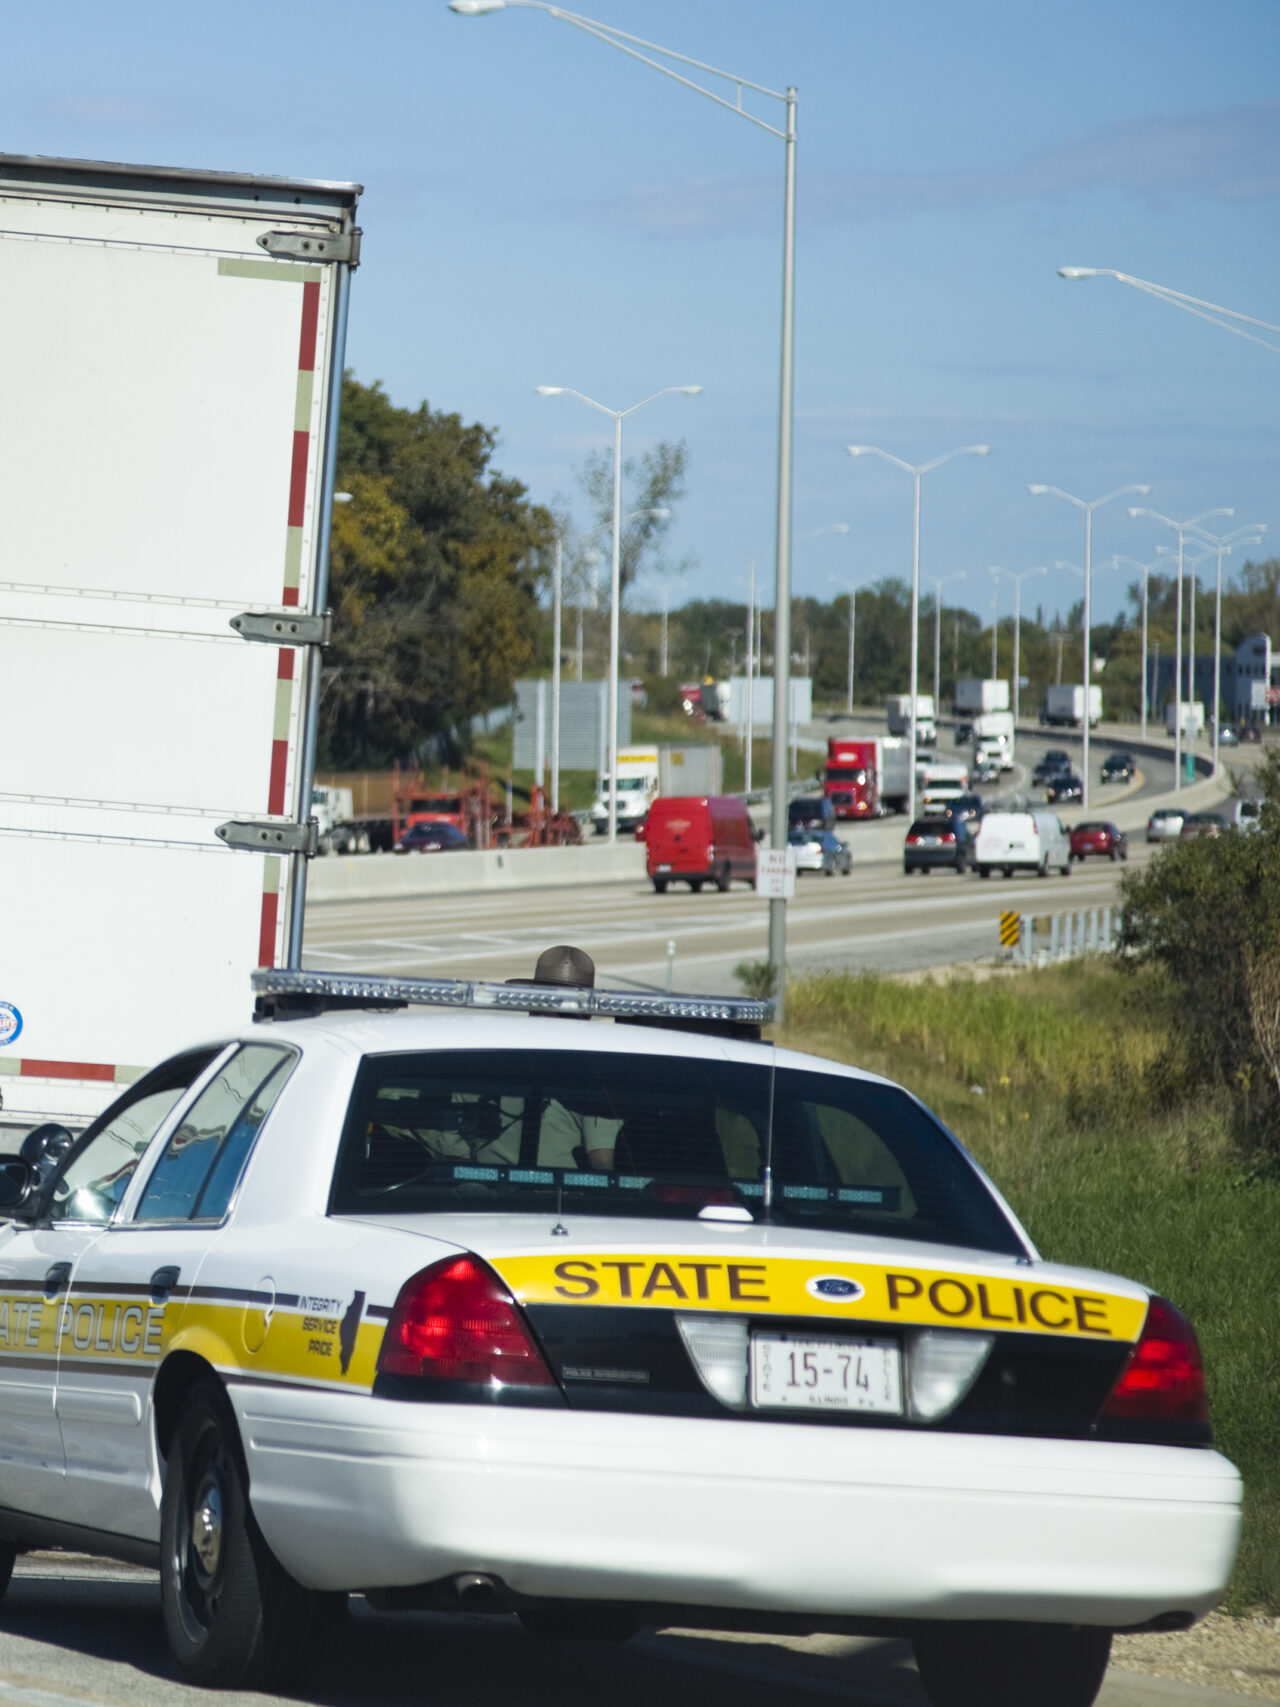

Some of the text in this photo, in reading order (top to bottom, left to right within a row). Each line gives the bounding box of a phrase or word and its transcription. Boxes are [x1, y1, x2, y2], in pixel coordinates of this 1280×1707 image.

[300, 1295, 342, 1314] INTEGRITY
[554, 1260, 1112, 1335] STATE POLICE
[55, 1302, 165, 1355] POLICE
[302, 1316, 338, 1335] SERVICE
[308, 1339, 333, 1356] PRIDE
[786, 1351, 869, 1392] 15-74
[809, 1395, 849, 1406] ILLINOIS
